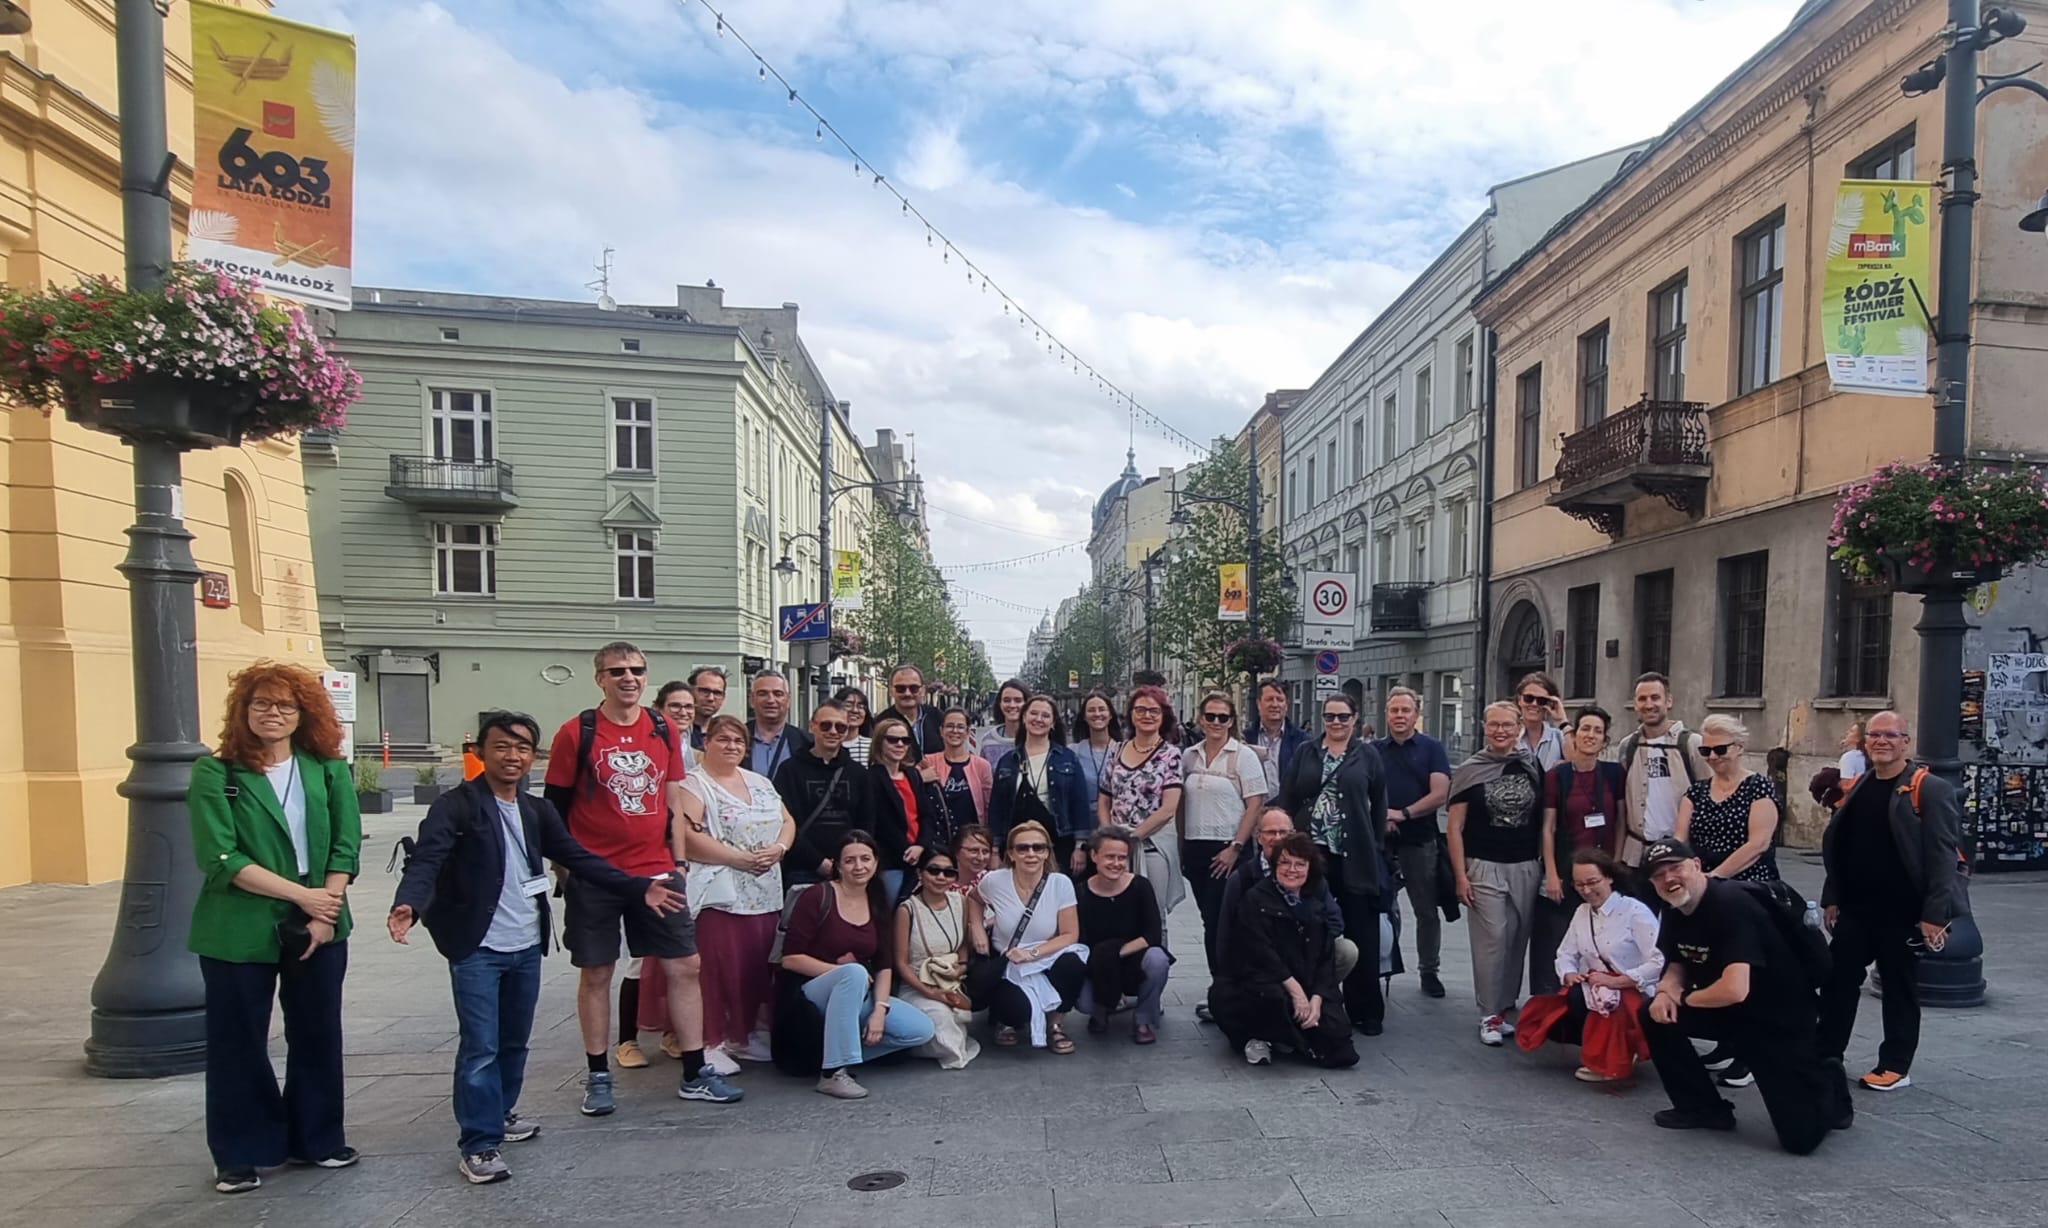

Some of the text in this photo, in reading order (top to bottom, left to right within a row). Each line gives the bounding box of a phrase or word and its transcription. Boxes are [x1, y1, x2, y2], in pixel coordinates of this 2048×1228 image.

[218, 127, 331, 194] 603
[218, 175, 267, 197] LATA
[1854, 240, 1901, 252] mBank
[1844, 272, 1905, 303] ŁÓDŹ
[1844, 295, 1904, 315] SUMMER
[1843, 307, 1905, 326] FESTIVAL
[1319, 589, 1342, 607] 30
[1306, 638, 1328, 647] Strefa
